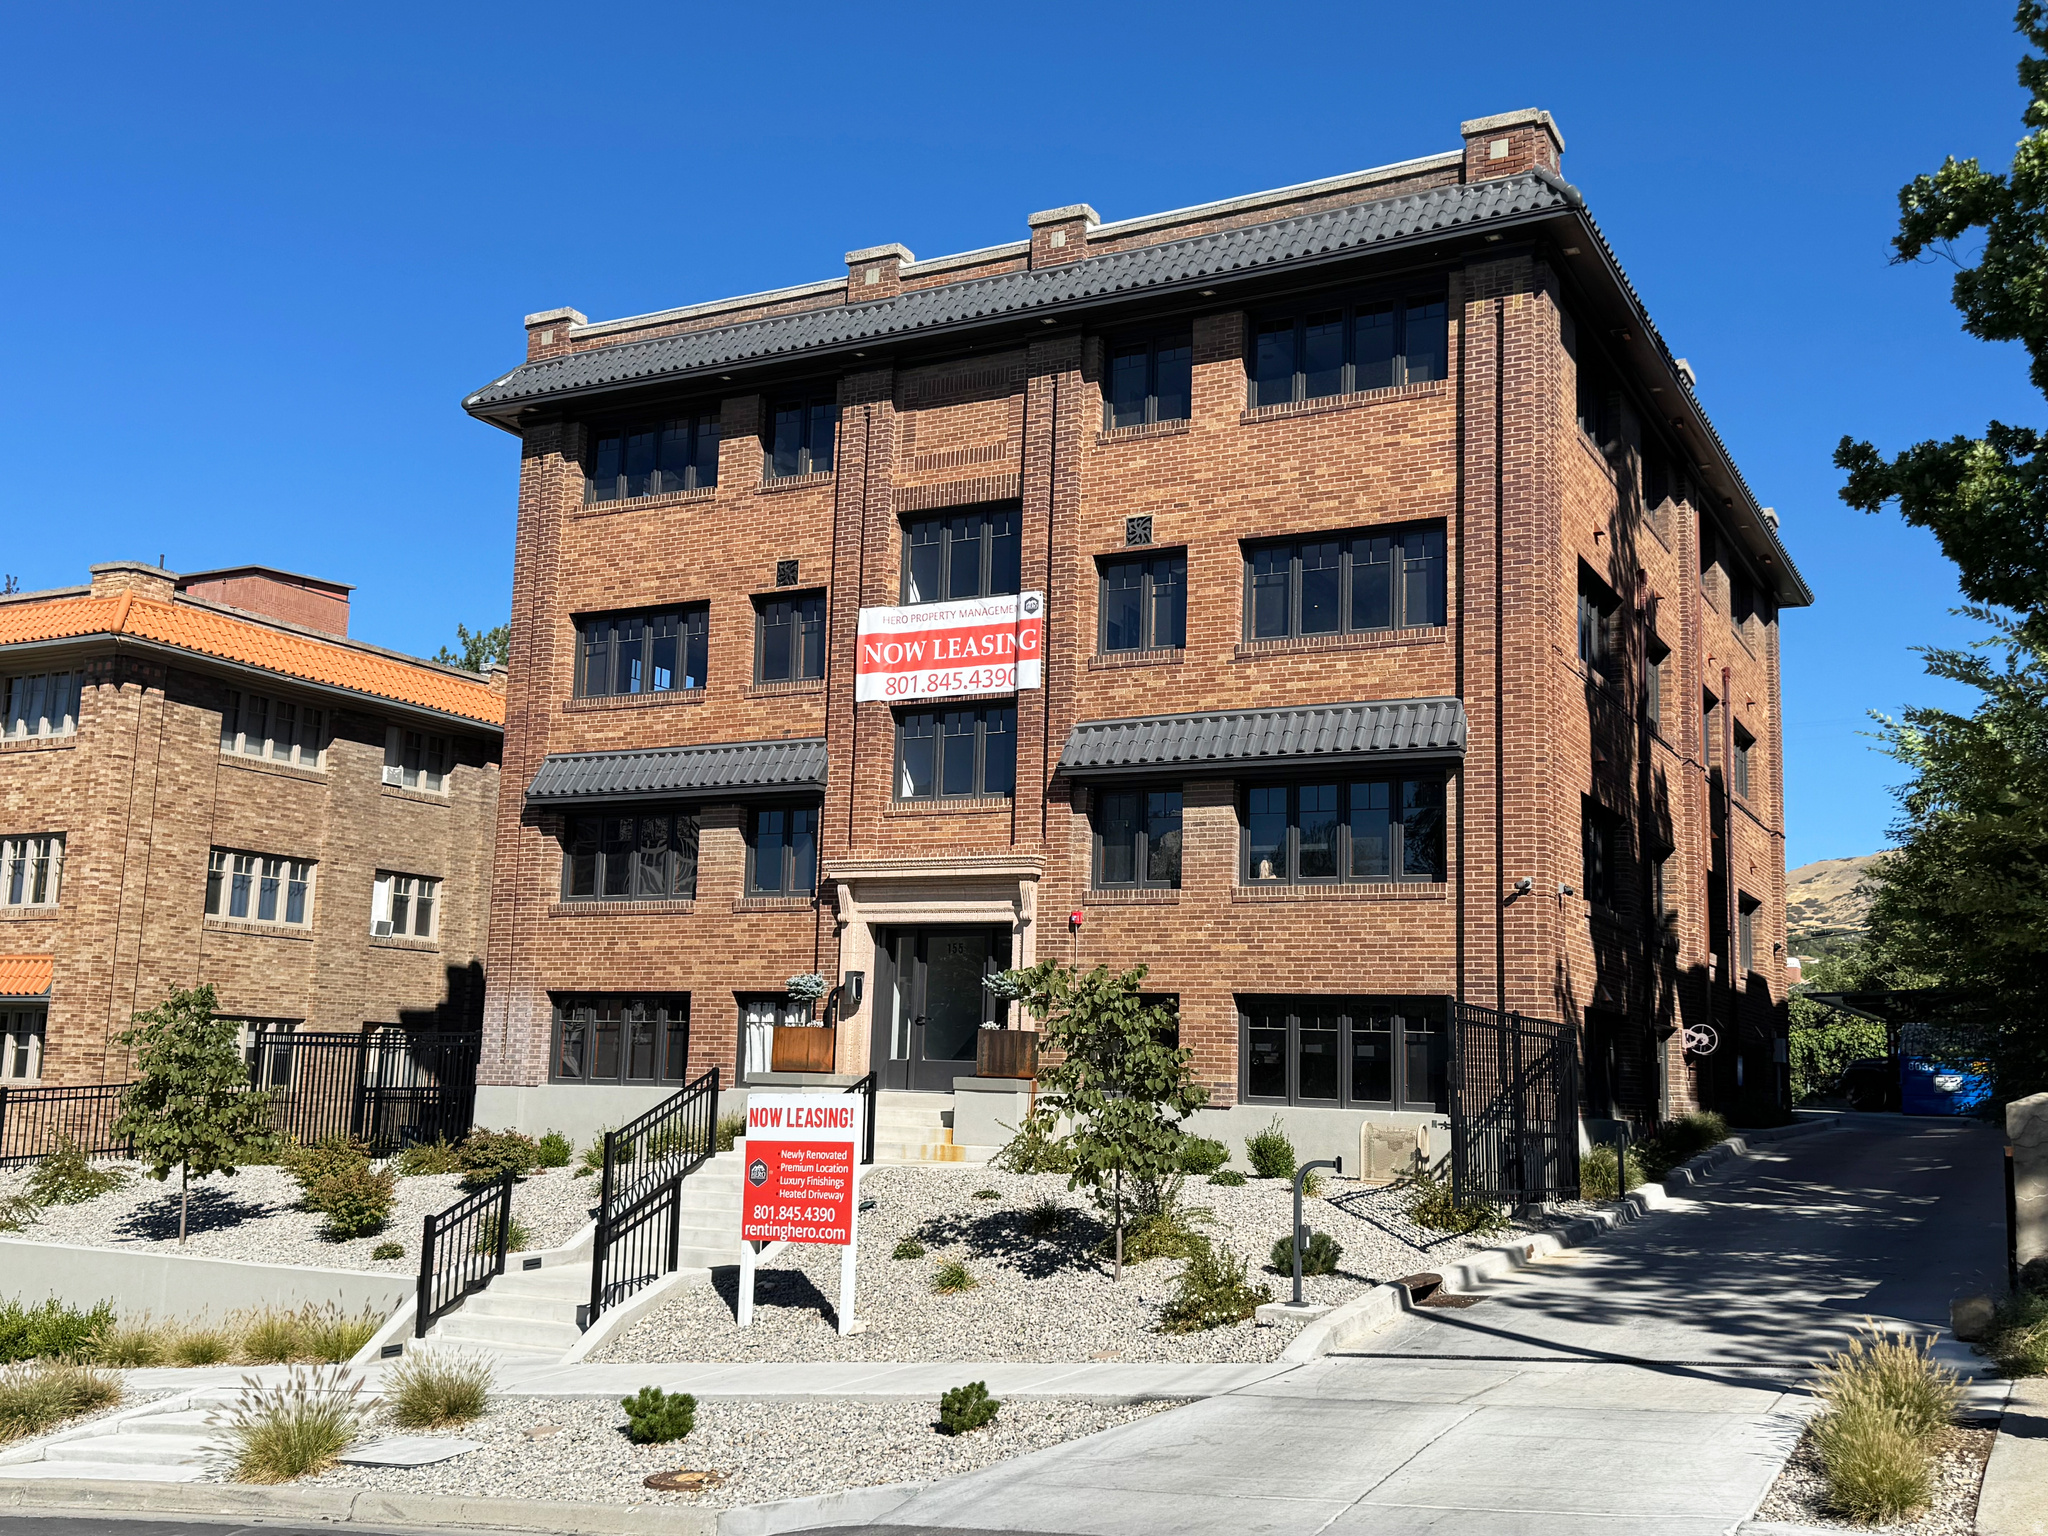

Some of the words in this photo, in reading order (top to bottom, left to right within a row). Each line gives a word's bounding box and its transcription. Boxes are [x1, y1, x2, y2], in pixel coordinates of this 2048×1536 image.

[883, 615, 908, 625] HERO
[911, 610, 957, 623] PROPERTY
[864, 640, 927, 665] NOW
[933, 628, 1037, 660] LEASING
[885, 667, 1017, 696] 801.845.4390
[948, 943, 964, 954] 155
[749, 1107, 783, 1128] NOW
[786, 1107, 854, 1128] LEASING!
[780, 1149, 805, 1161] Newly
[806, 1150, 848, 1160] Renovated
[780, 1162, 814, 1172] Premium
[815, 1163, 848, 1173] Location
[779, 1176, 805, 1188] Luxury
[806, 1176, 845, 1190] Finishings
[779, 1189, 807, 1199] Heated
[808, 1190, 844, 1203] Driveway
[753, 1205, 836, 1222] 801.845.4390
[744, 1221, 846, 1241] rentinghero.com
